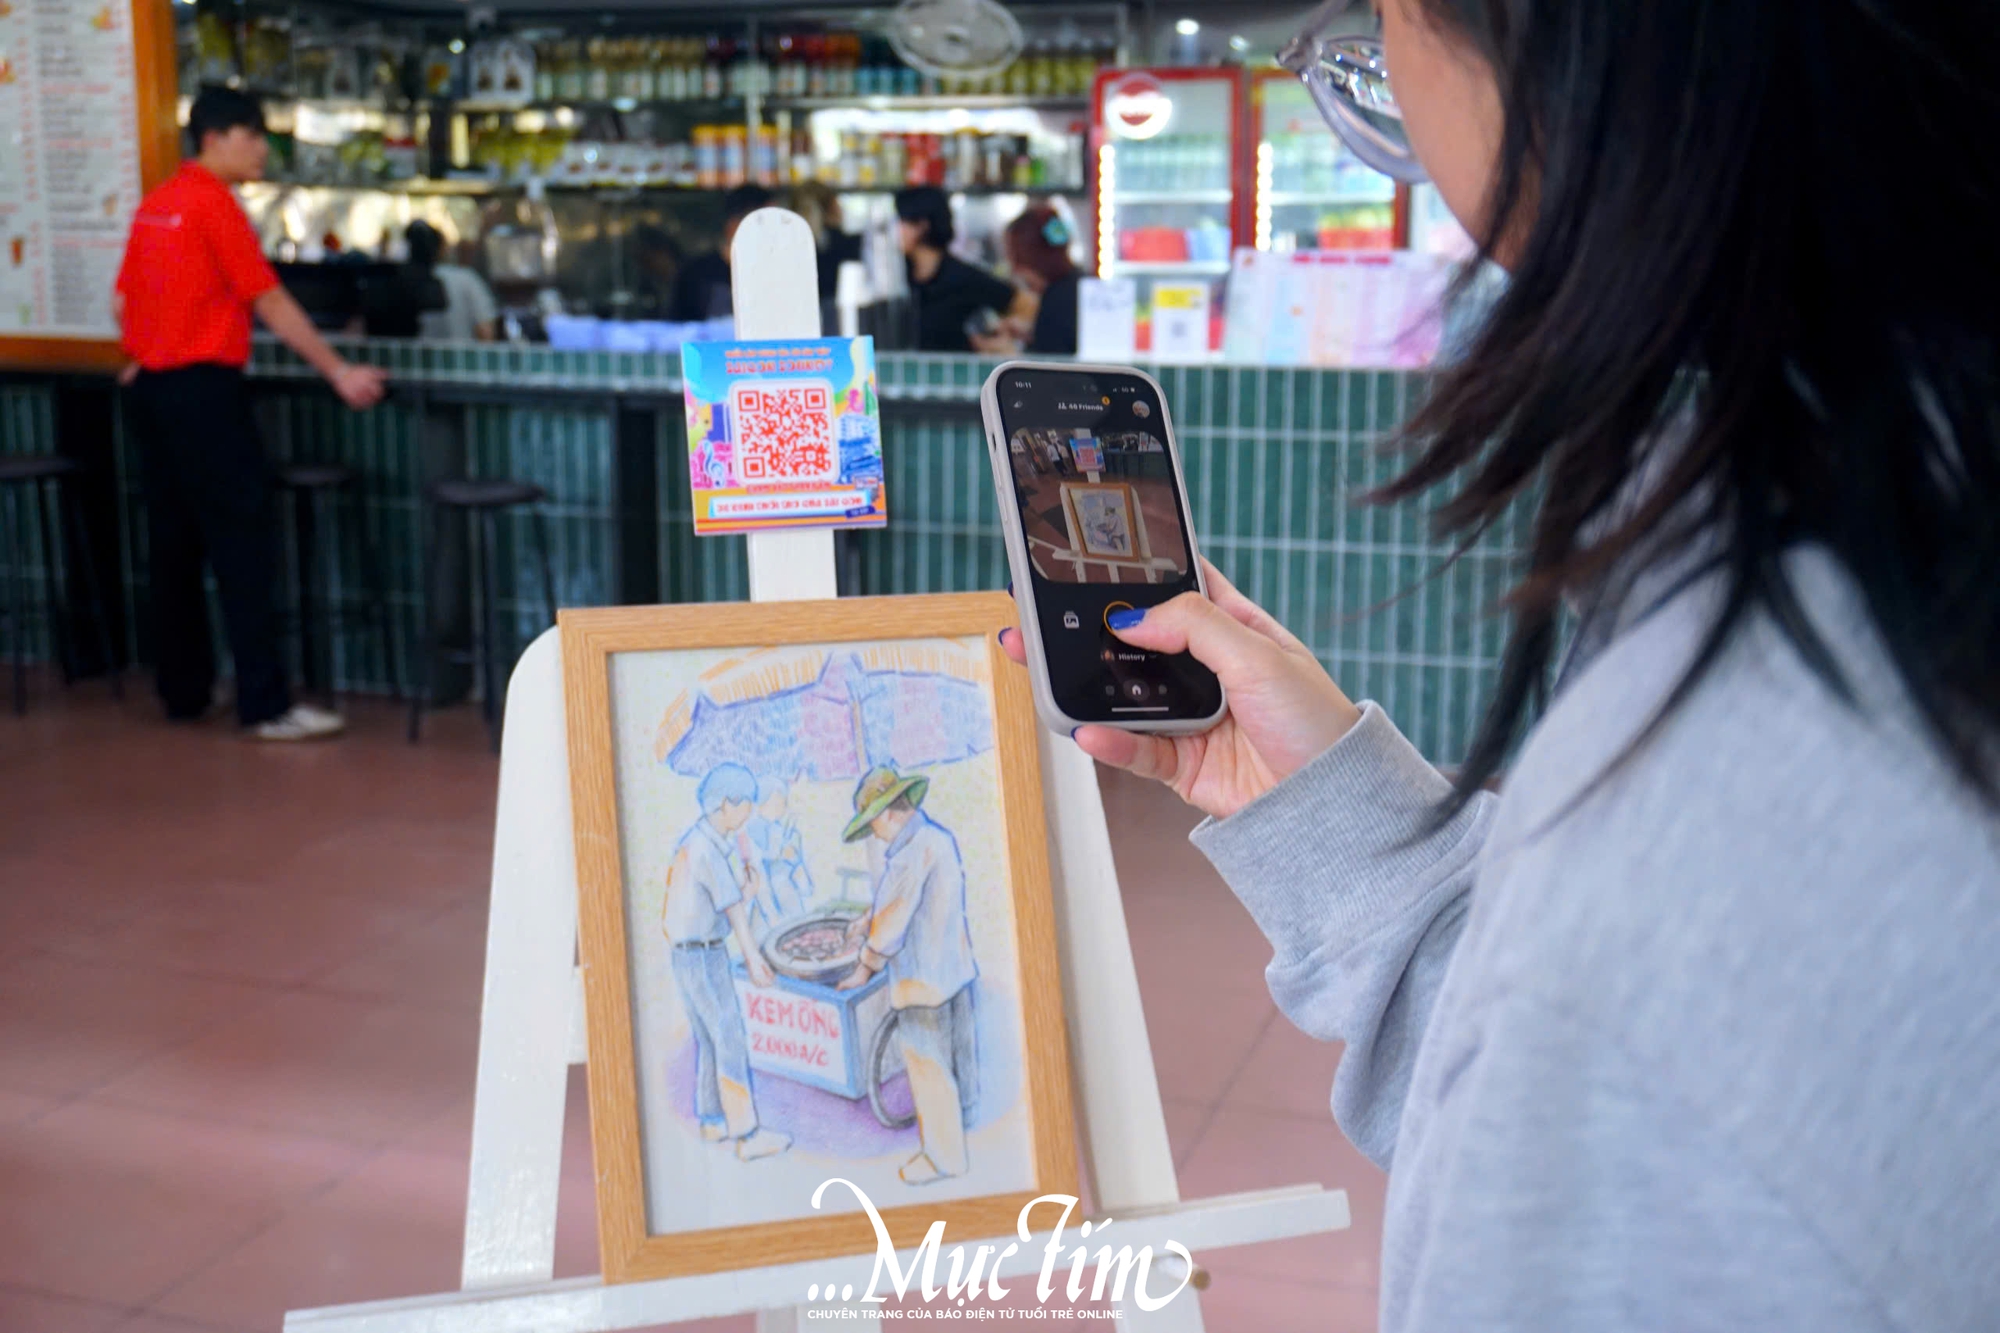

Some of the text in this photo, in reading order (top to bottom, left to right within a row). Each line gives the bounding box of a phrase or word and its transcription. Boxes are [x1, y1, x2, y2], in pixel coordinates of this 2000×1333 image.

[1015, 381, 1032, 390] 10:11
[1078, 402, 1104, 412] Friends
[1118, 652, 1146, 662] History
[746, 992, 795, 1029] KEM
